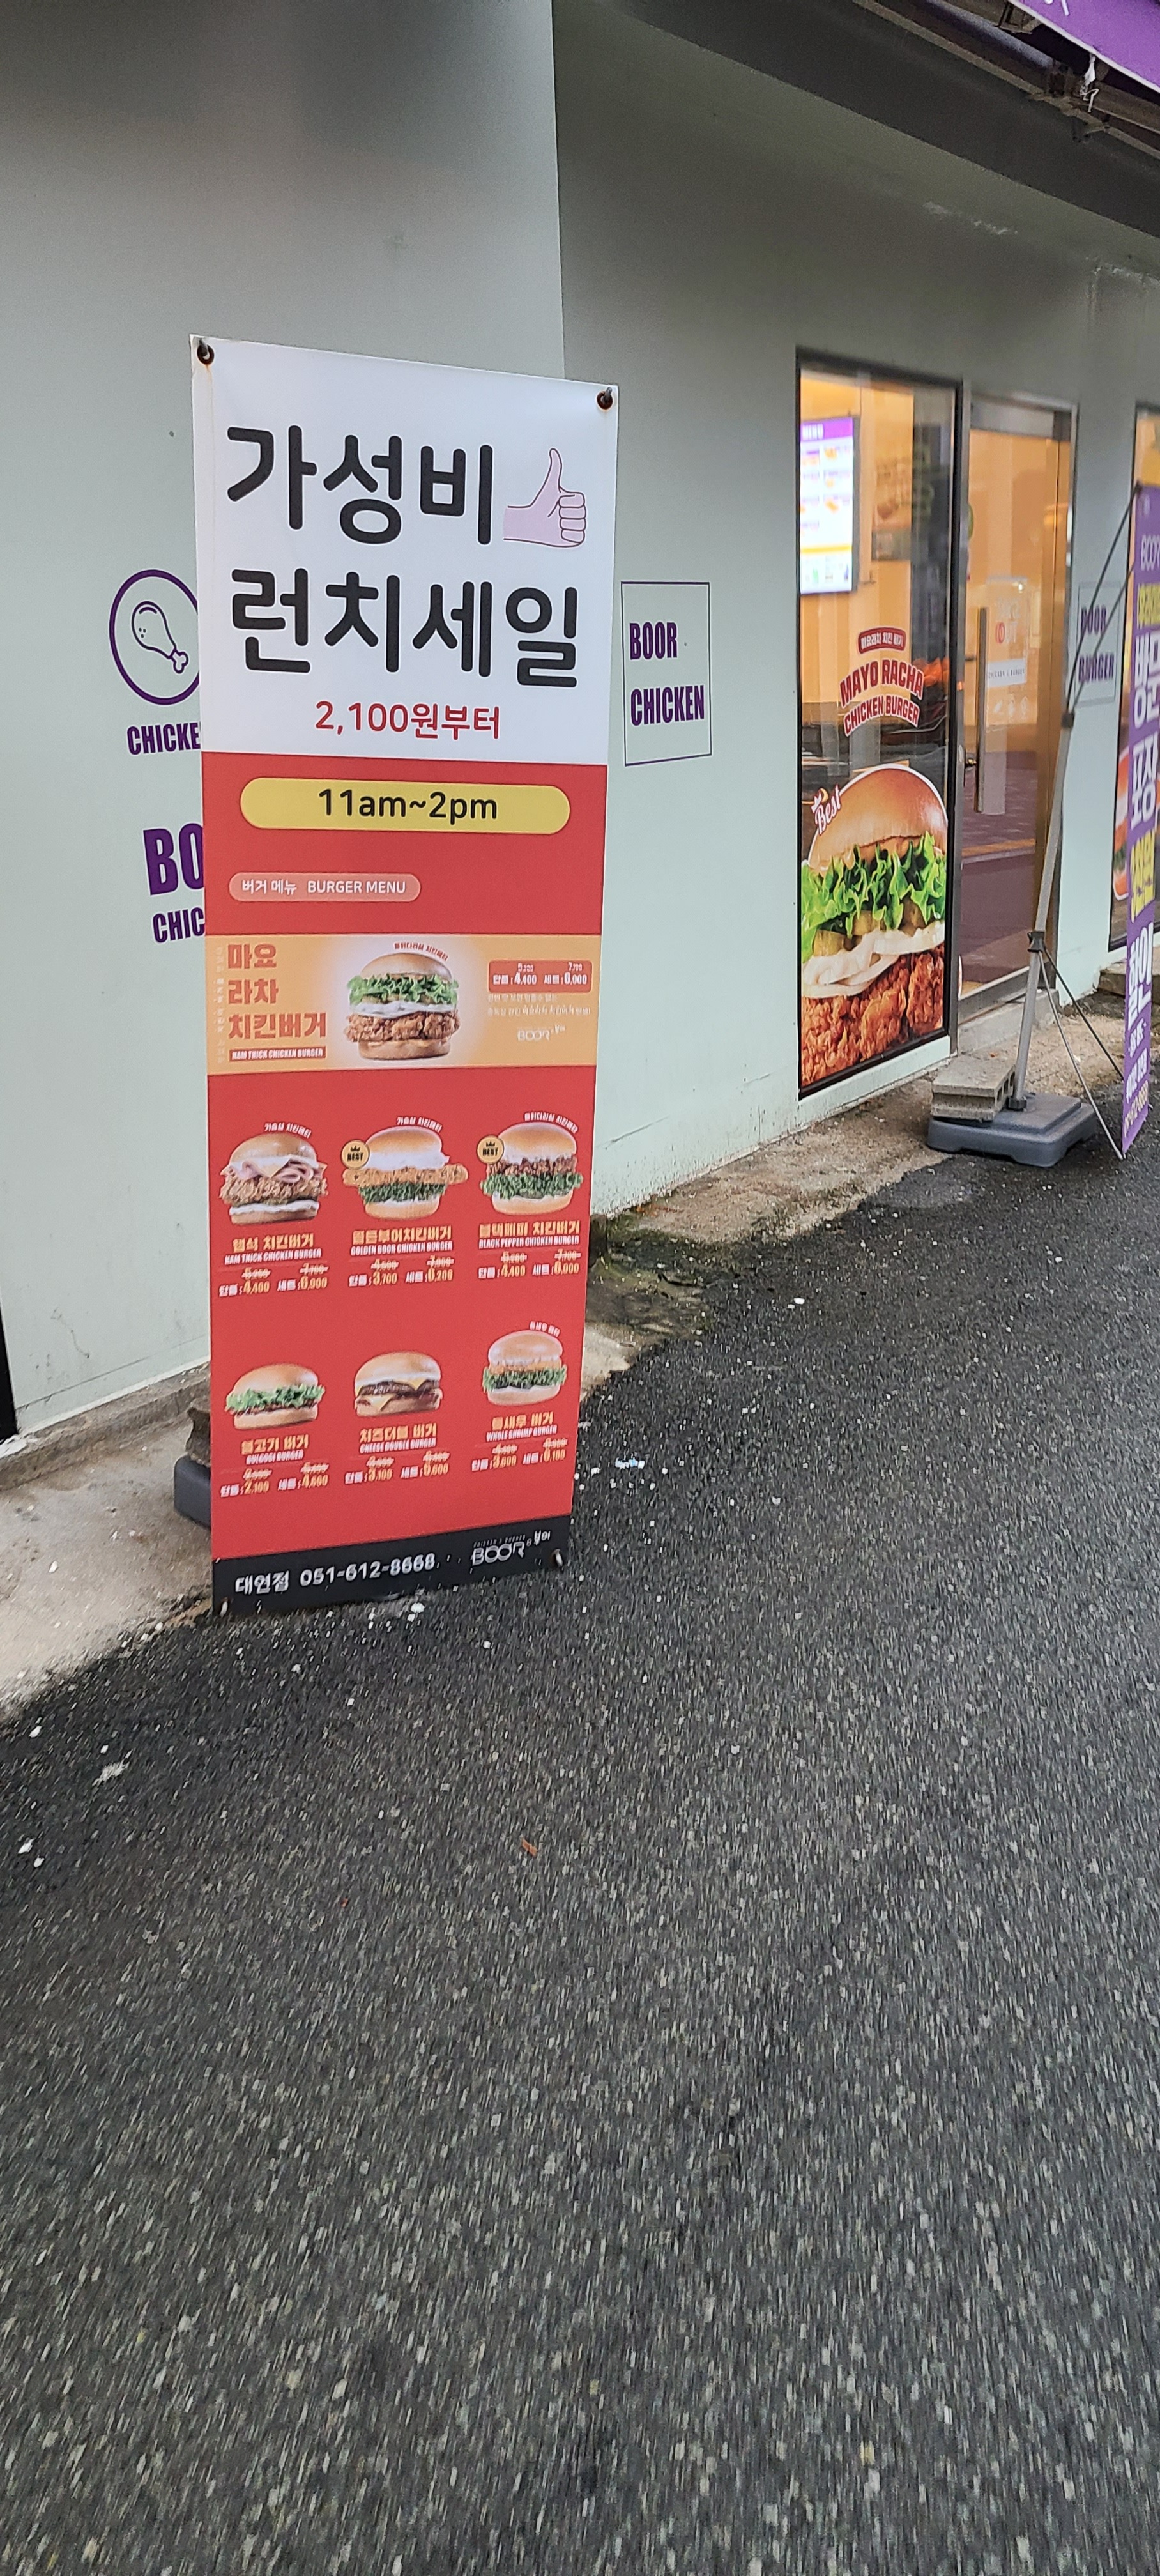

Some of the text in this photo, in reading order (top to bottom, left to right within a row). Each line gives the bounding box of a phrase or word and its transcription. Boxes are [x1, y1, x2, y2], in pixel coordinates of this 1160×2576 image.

[227, 425, 492, 545] 가성비
[231, 568, 577, 687] 런치세일
[629, 622, 678, 660] BOOR
[839, 659, 924, 708] MAYO RACHA
[630, 684, 705, 726] CHICKEN
[843, 695, 920, 737] CHICKEN BURGER
[316, 701, 499, 740] 2,100원부터
[127, 721, 201, 755] CHICKE
[318, 789, 498, 825] 11am~2pm
[814, 783, 841, 835] Best
[241, 879, 406, 894] 버거 메뉴 BURGER MENU
[227, 944, 277, 969] 마요
[228, 977, 279, 1004] 라차
[229, 1012, 326, 1039] 치킨버거
[268, 1048, 296, 1059] CHICKEN
[298, 1048, 323, 1058] BURGER
[347, 1153, 363, 1162] BEST
[263, 1233, 314, 1250] 치킨버거
[533, 1220, 580, 1236] 치킨버거
[263, 1250, 293, 1262] CHICKEN
[294, 1248, 321, 1259] BURGER
[351, 1245, 376, 1256] GOLDEN
[397, 1242, 425, 1254] CHICKEN
[426, 1241, 453, 1252] BURGER
[478, 1238, 500, 1249] BLACK
[501, 1237, 524, 1248] PEPPER
[524, 1236, 553, 1246] CHICKEN
[283, 1434, 309, 1450] 버거
[472, 1541, 525, 1566] BOOR
[234, 1552, 436, 1595] 대연점 051-612-8668
